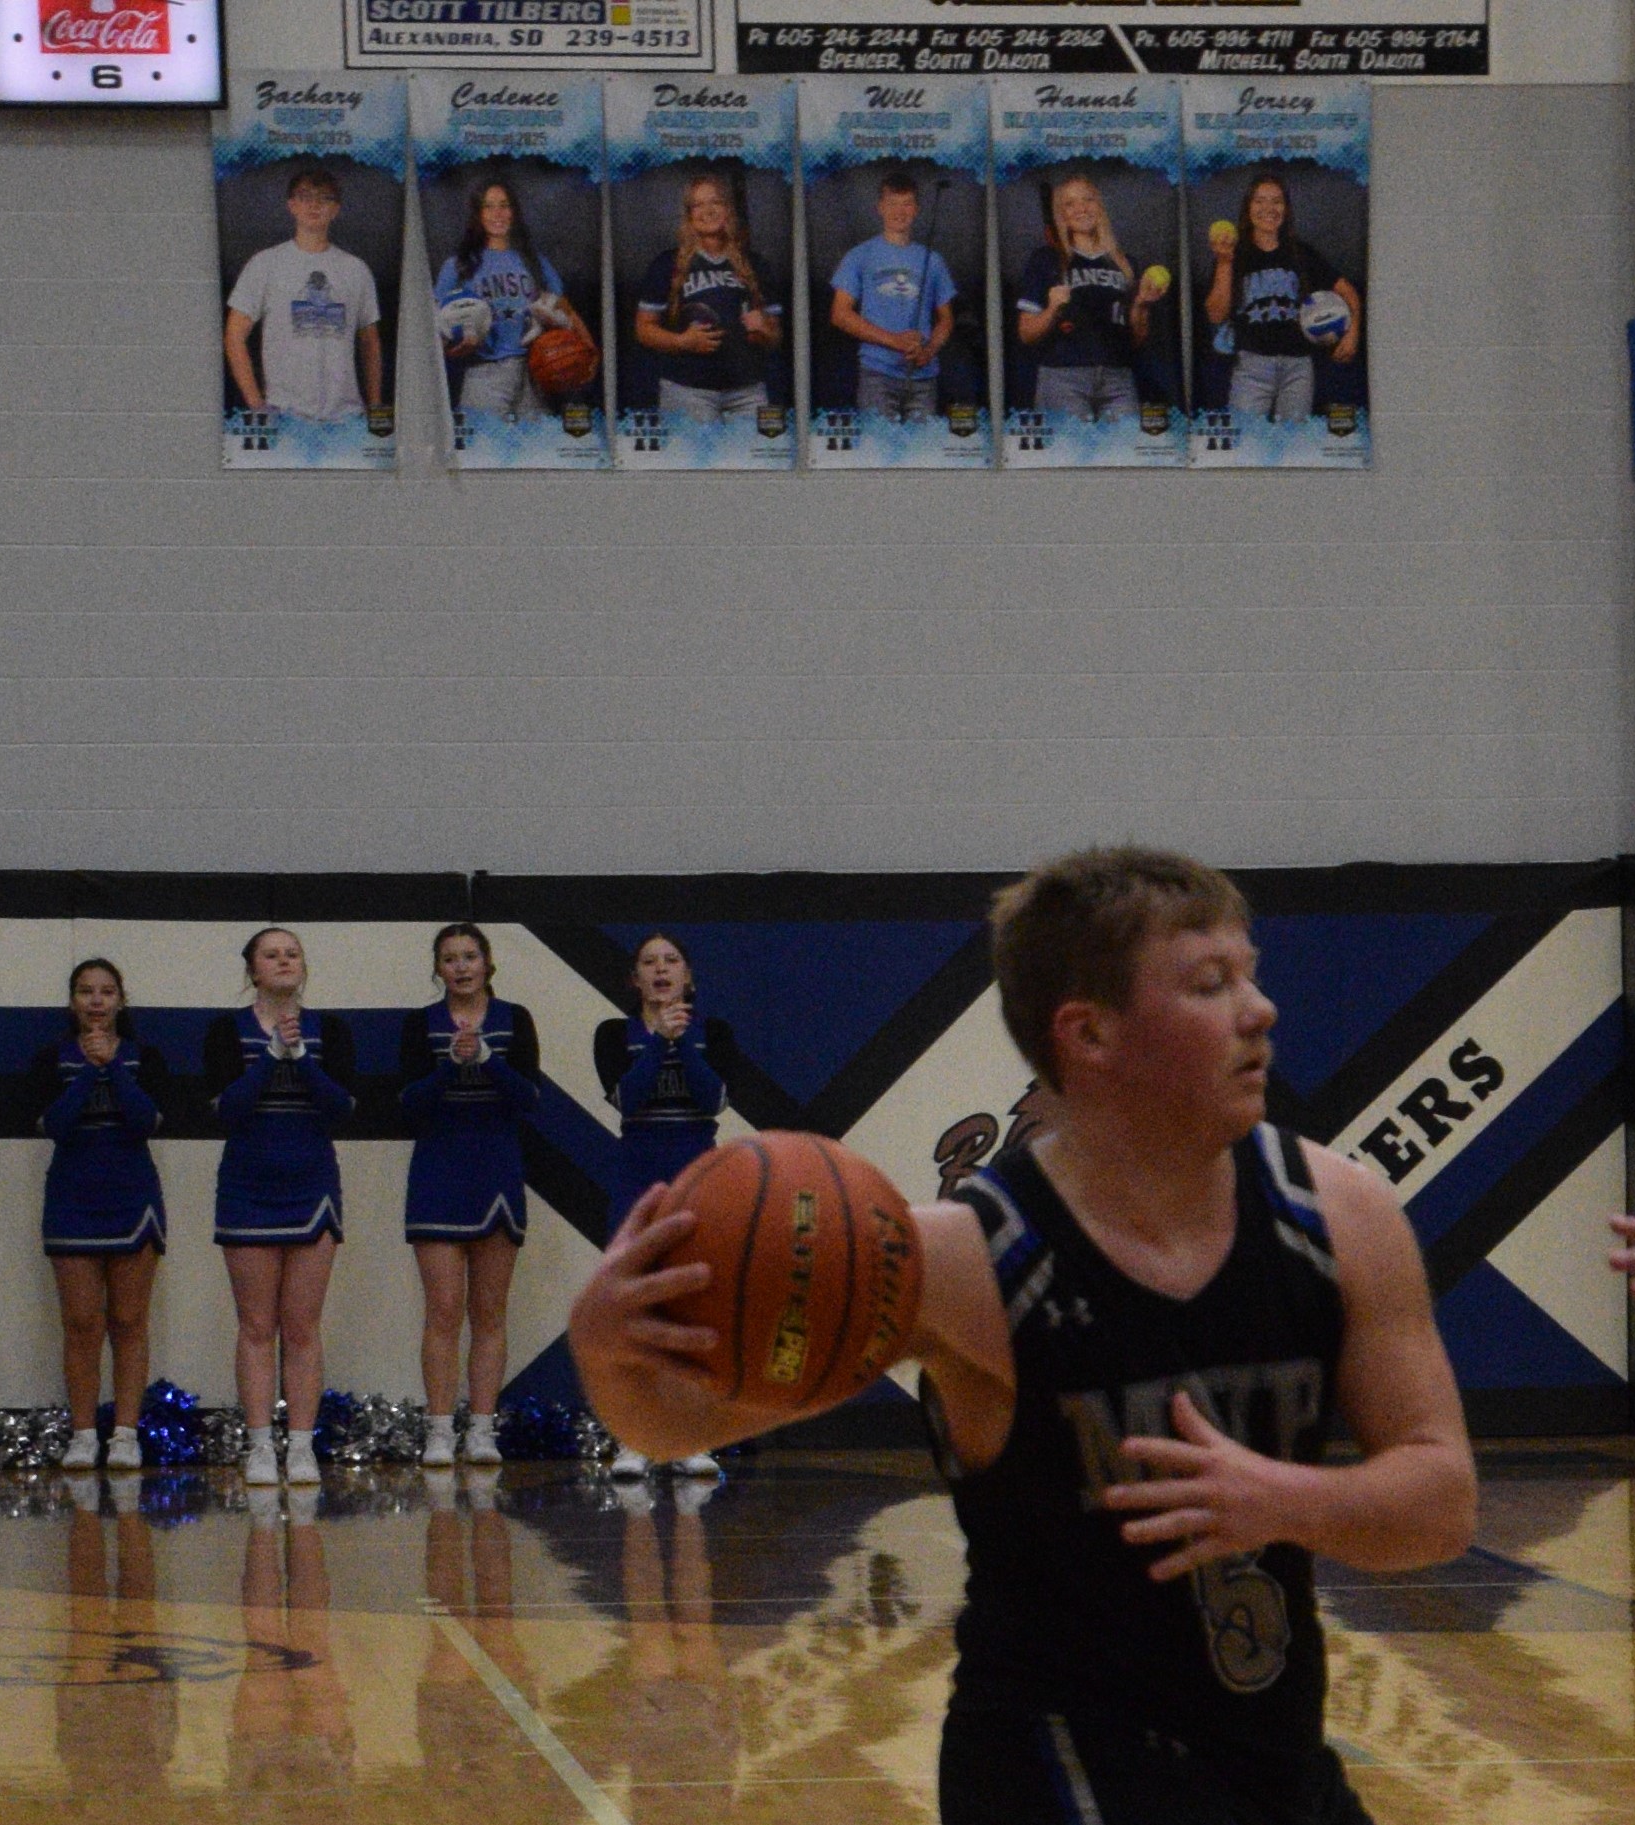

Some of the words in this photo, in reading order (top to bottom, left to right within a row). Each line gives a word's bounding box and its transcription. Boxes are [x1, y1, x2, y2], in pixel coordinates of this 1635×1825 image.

[370, 0, 466, 20] SCOTT
[479, 0, 601, 22] TILBERG
[369, 28, 500, 46] ALEXANDRIA,
[509, 28, 545, 46] SD
[566, 28, 691, 47] 239-4513
[776, 28, 919, 46] 605-246-2344
[819, 47, 905, 71] SPENCER,
[915, 47, 972, 70] SOUTH
[983, 48, 1051, 71] DAKOTA
[1198, 49, 1285, 72] MITCHELL,
[1294, 48, 1349, 71] SOUTH
[1361, 48, 1426, 71] DAKOTA
[90, 64, 123, 89] 6
[256, 80, 363, 110] Zachary
[451, 82, 559, 110] Cadence
[653, 84, 748, 107] Dakota
[865, 86, 928, 108] Will
[1035, 84, 1138, 108] Hannah
[1235, 86, 1315, 116] Jersey
[1347, 1037, 1504, 1186] ERS
